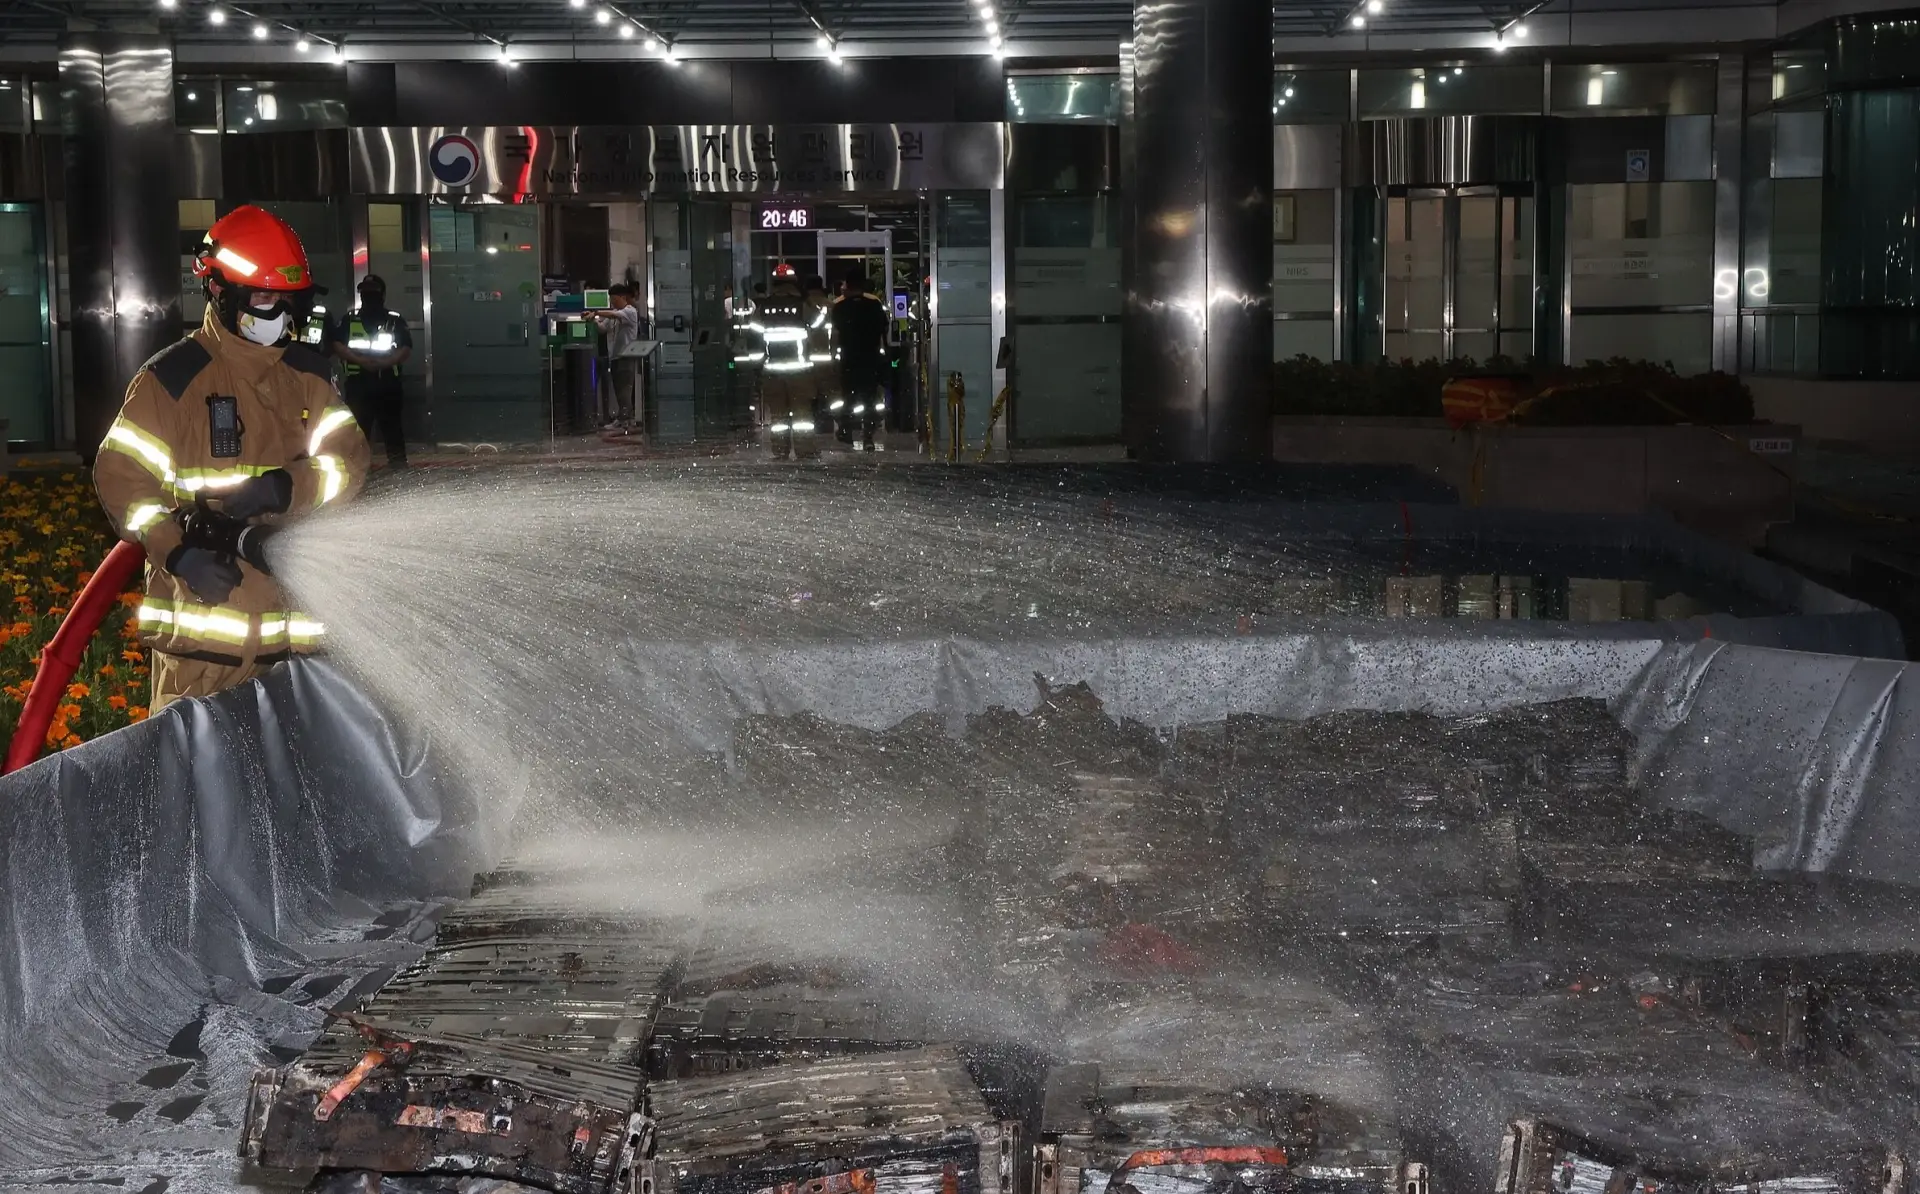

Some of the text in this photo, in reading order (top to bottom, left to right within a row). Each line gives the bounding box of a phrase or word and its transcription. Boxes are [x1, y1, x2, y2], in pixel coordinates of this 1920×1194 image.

[541, 168, 615, 184] National
[727, 167, 816, 183] Resources
[823, 167, 886, 182] Service
[762, 209, 807, 228] 20:46
